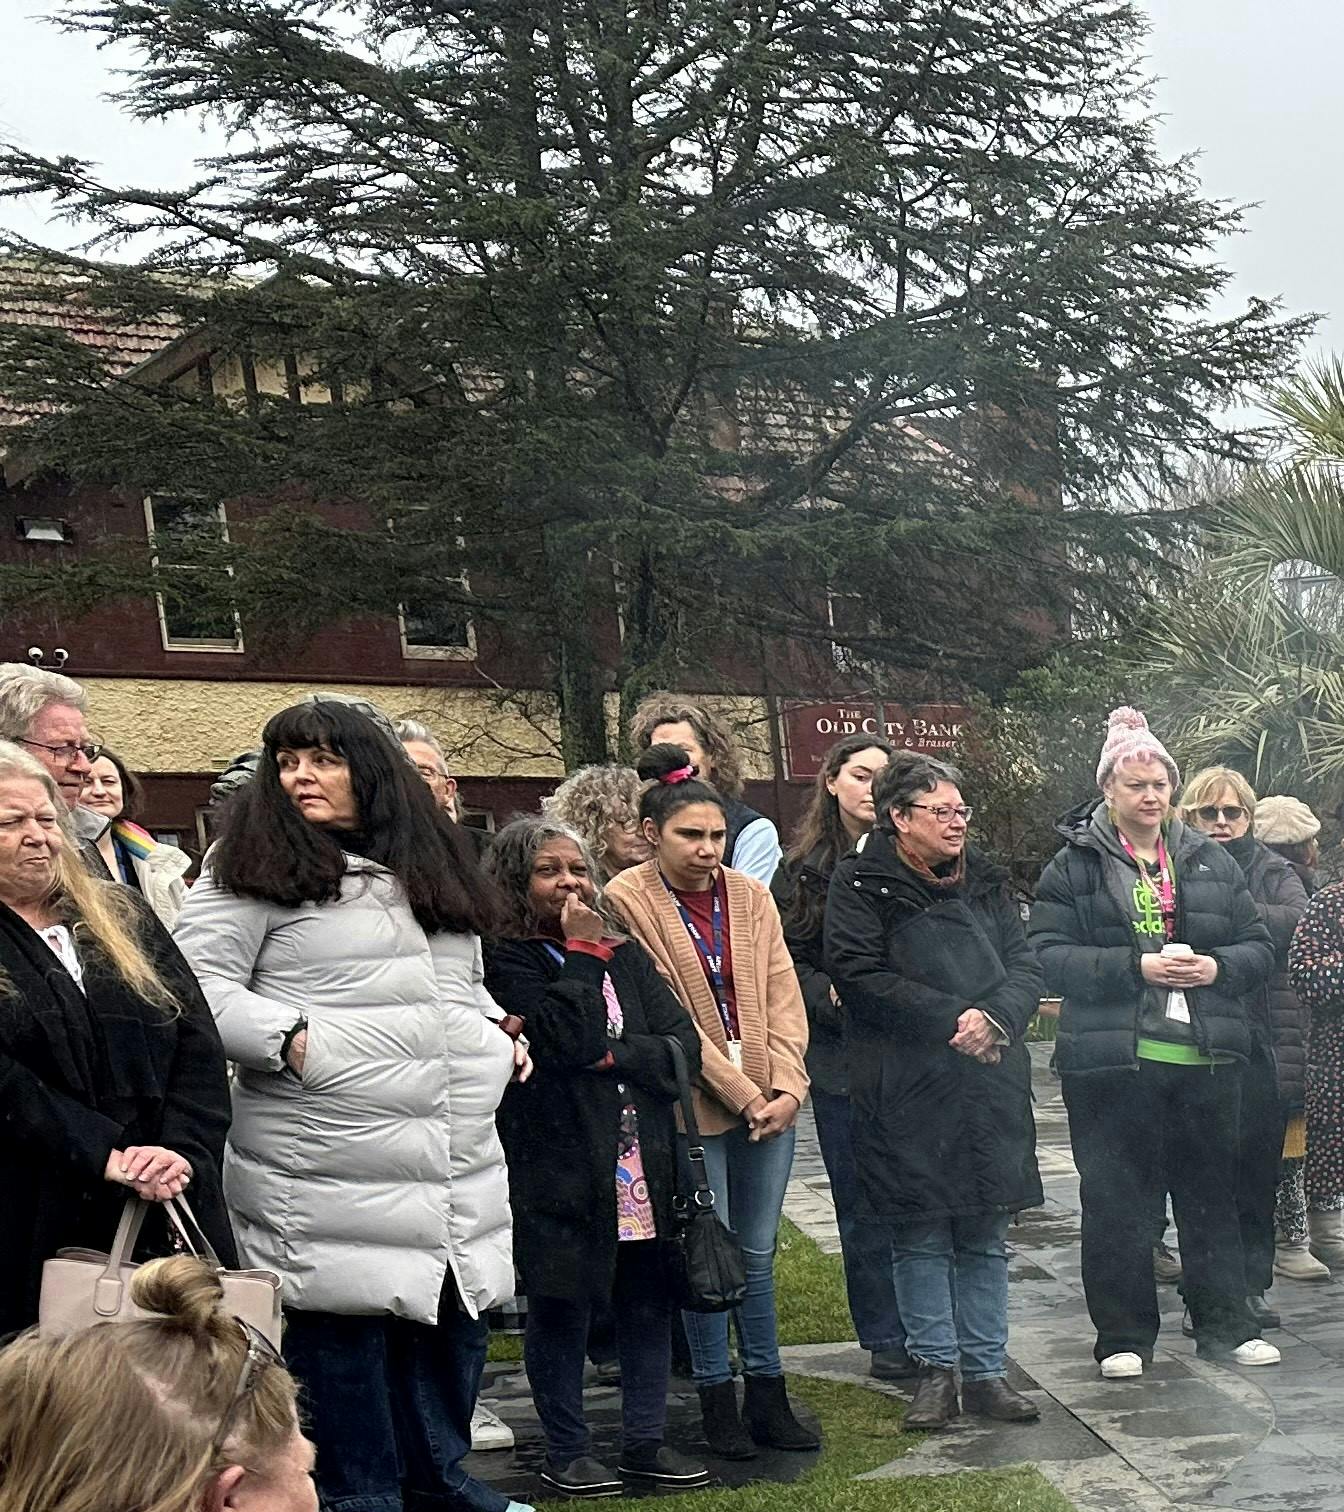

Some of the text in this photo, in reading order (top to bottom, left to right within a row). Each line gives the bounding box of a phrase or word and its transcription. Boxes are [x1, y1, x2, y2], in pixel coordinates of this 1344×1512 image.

[837, 708, 862, 719] THE
[816, 717, 964, 737] OLD CTY BANK
[904, 737, 914, 747] &
